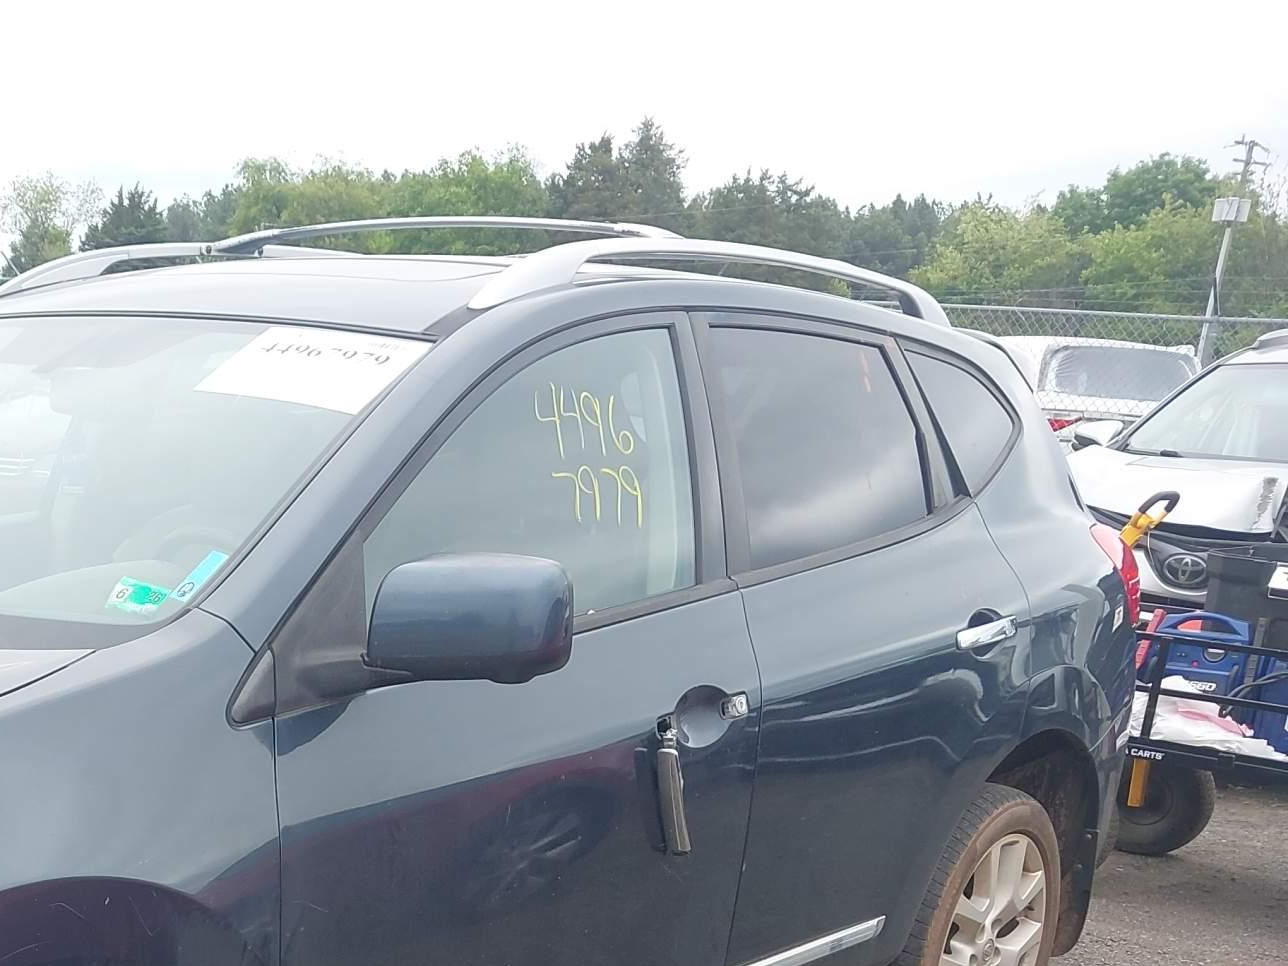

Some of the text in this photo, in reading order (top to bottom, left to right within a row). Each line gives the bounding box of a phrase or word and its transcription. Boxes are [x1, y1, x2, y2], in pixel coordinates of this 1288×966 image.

[534, 380, 634, 459] 4496
[551, 465, 643, 528] 7979
[1130, 748, 1163, 760] CARTS
